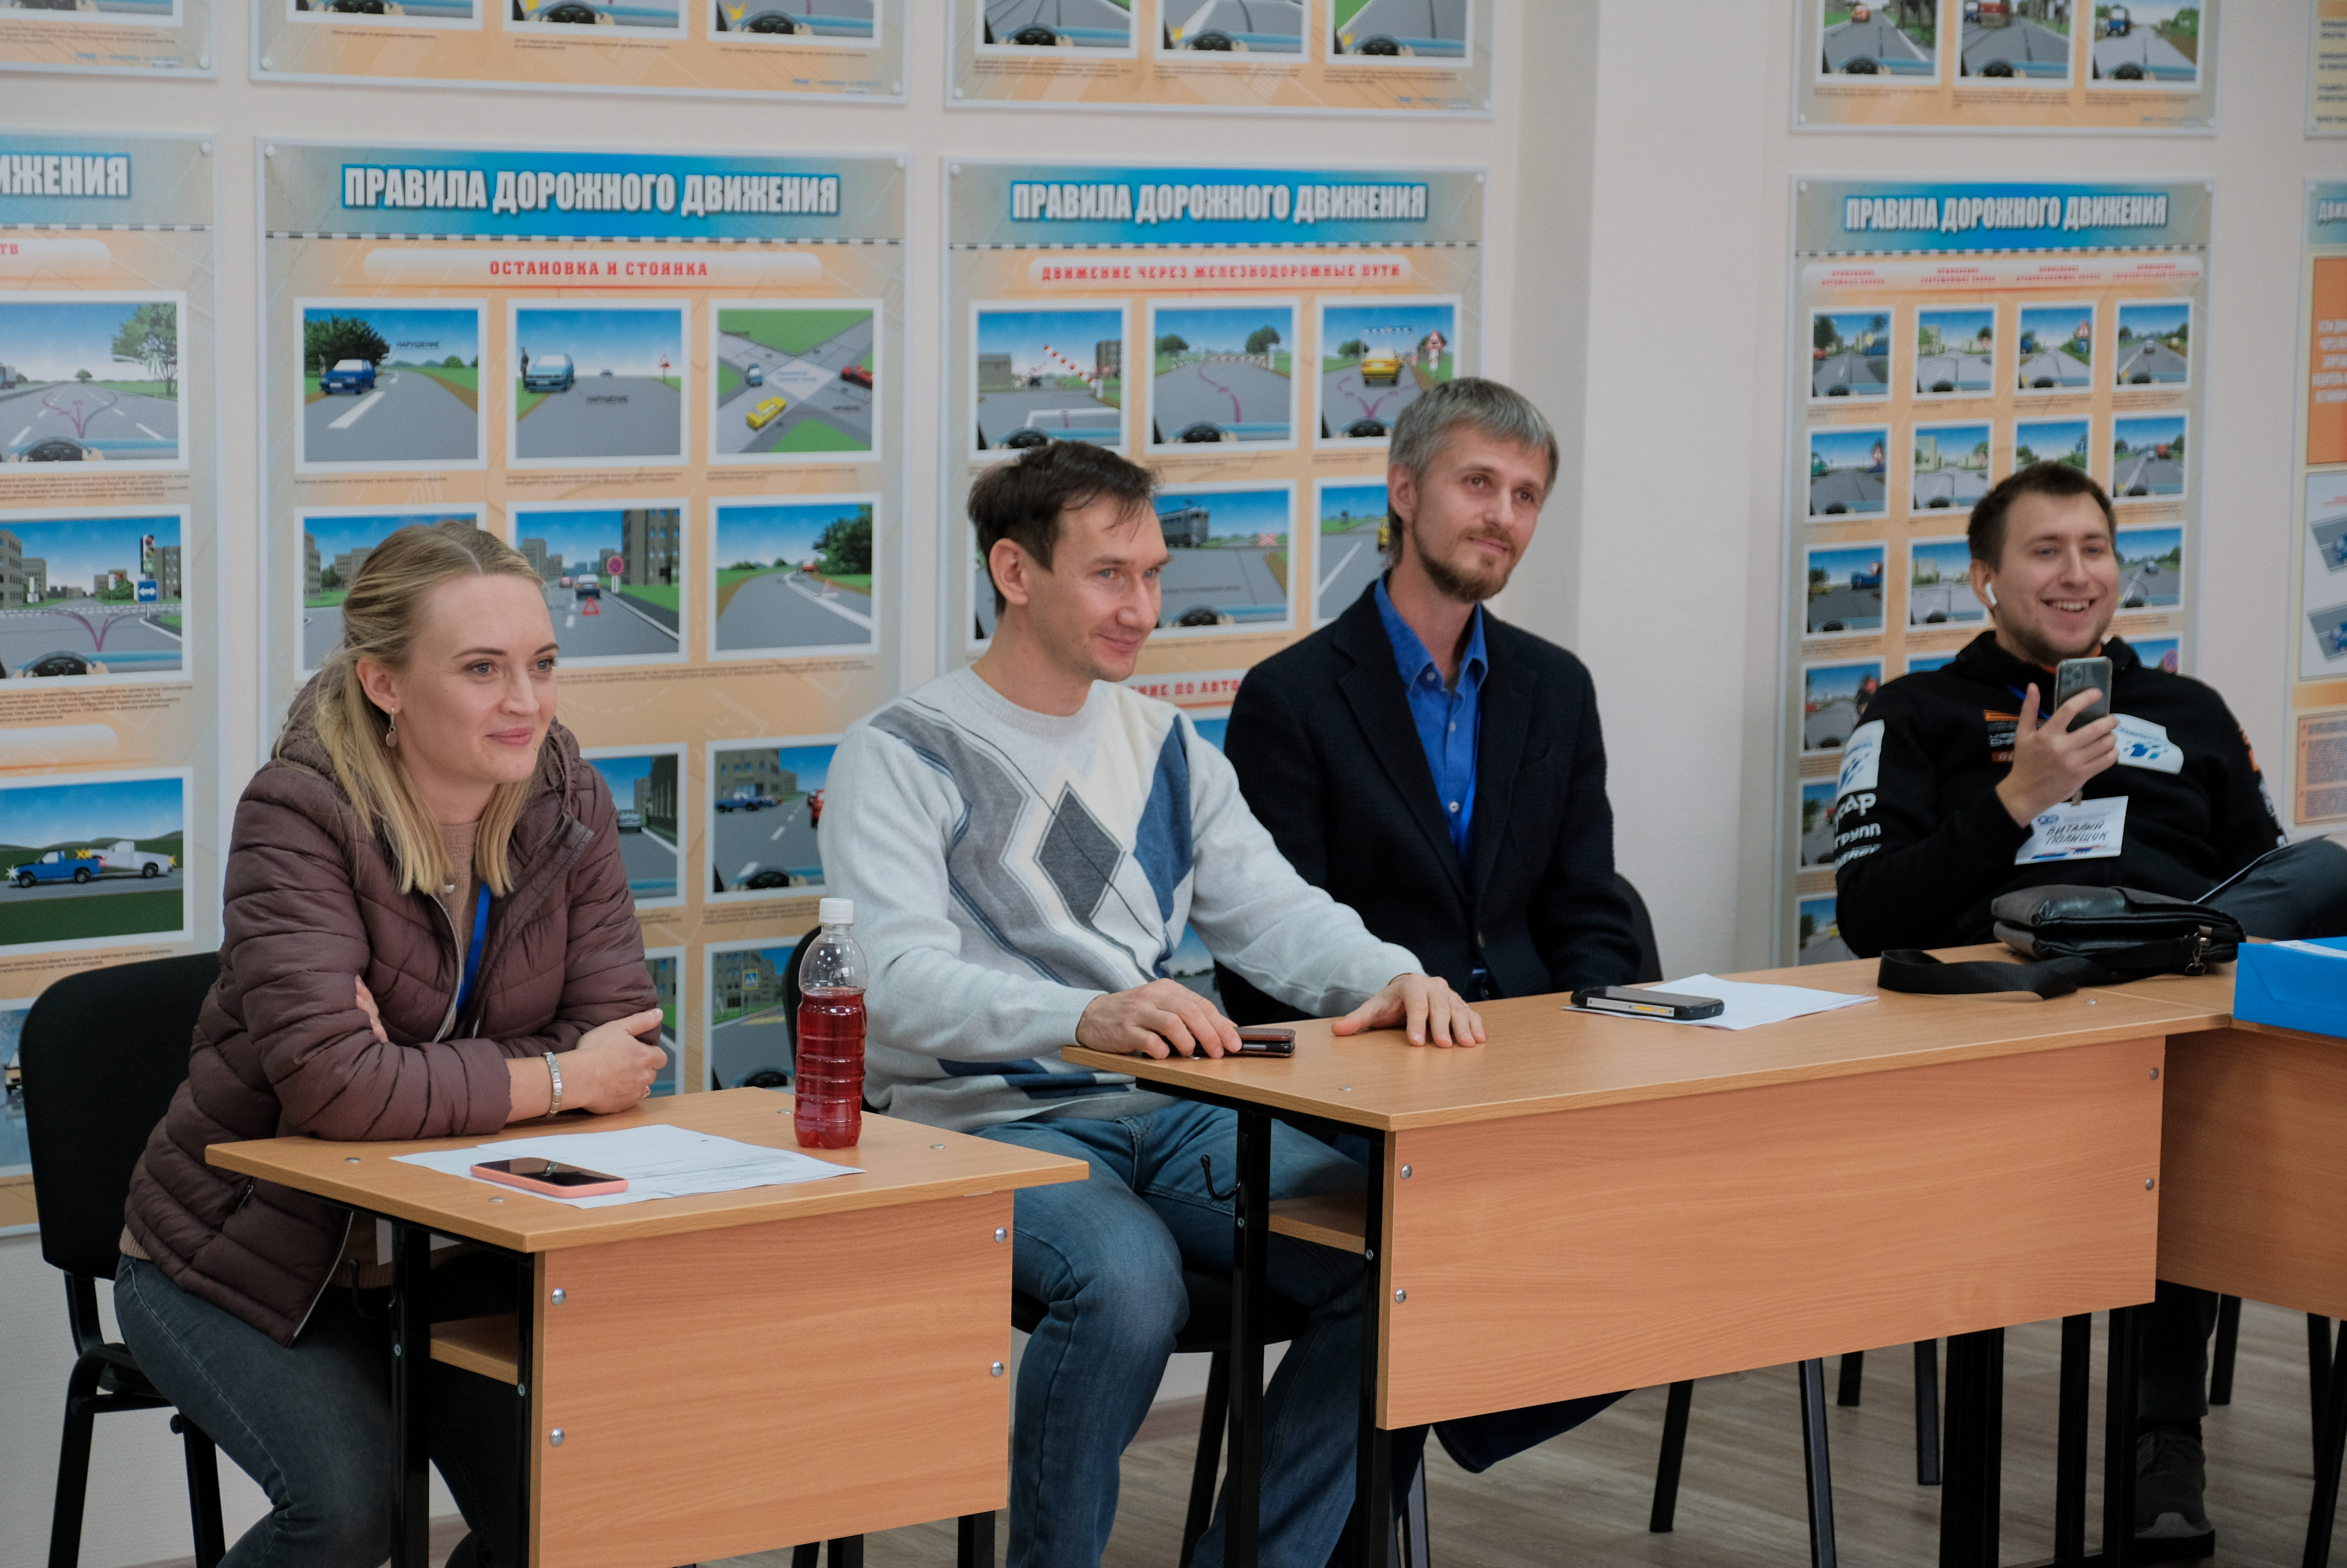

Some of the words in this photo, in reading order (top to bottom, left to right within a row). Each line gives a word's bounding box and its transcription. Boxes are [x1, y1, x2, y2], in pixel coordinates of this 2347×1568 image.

[345, 167, 488, 209] ПРАВИЛА
[492, 171, 676, 215] ДОРОЖНОГО
[681, 174, 838, 218] ДВИЖЕНИЯ
[1013, 183, 1133, 220] ПРАВИЛА
[1135, 184, 1291, 225] ДОРОЖНОГО
[1293, 184, 1427, 224] ДВИЖЕНИЯ
[1847, 197, 1939, 233] ПРАВИЛА
[1940, 196, 2062, 233] ДОРОЖНОГО
[2063, 195, 2168, 232] ДВИЖЕНИЯ
[490, 261, 599, 275] ОСТАНОВКА
[606, 262, 617, 275] И
[626, 262, 708, 276] СТОЯНКА
[1042, 265, 1132, 281] ДВИЖЕНИЕ
[1138, 265, 1187, 278] ЧЕРЕЗ
[1195, 264, 1356, 278] ЖЕЛЕЗНОДОРОЖНЫЕ
[1362, 264, 1400, 276] ПУТИ
[1175, 682, 1194, 695] ПО
